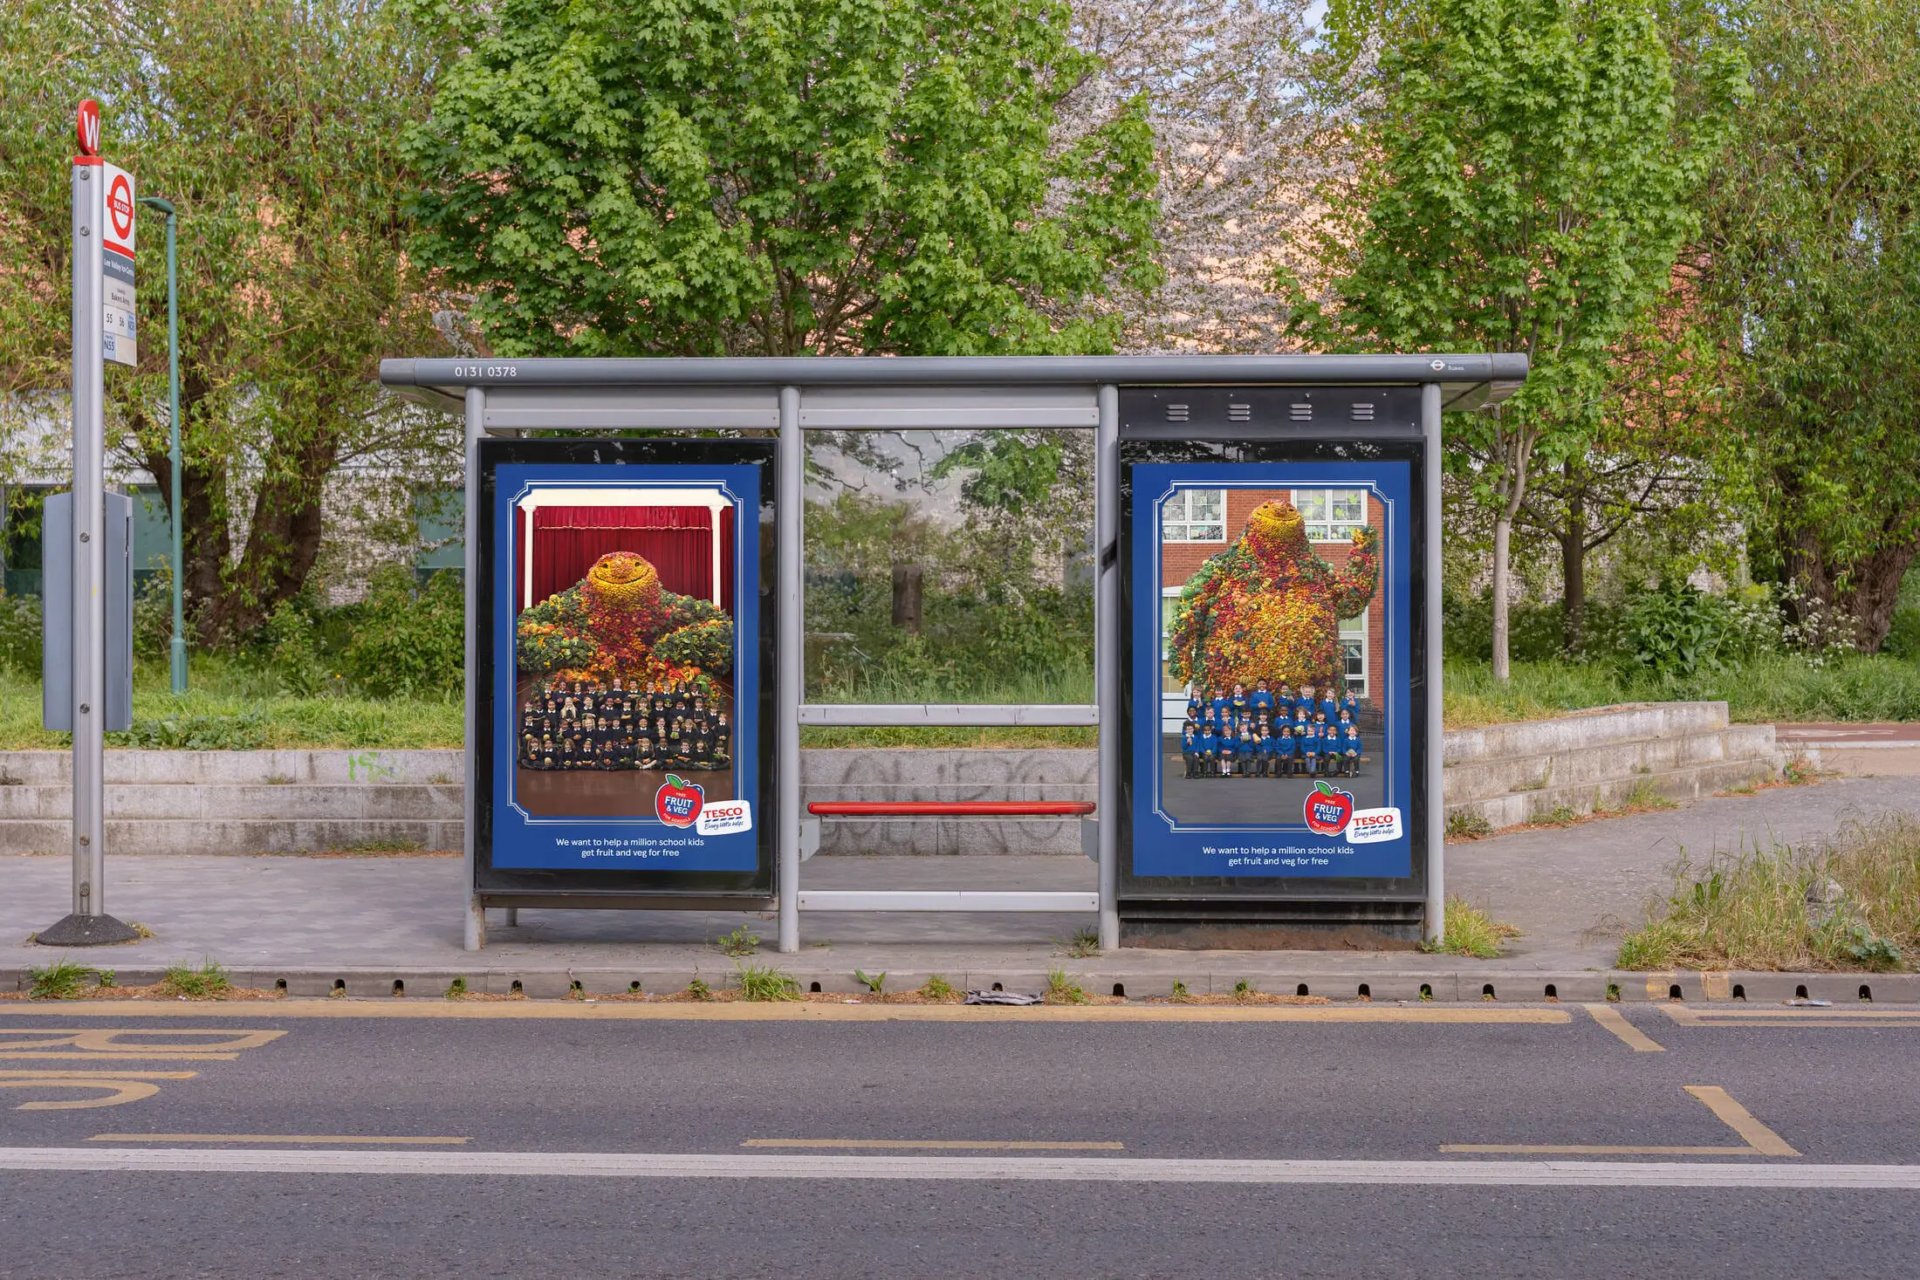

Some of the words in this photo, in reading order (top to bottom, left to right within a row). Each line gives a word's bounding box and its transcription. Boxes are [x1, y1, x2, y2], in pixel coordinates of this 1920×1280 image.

[83, 110, 100, 151] W
[106, 313, 113, 324] 55
[454, 366, 482, 377] 0131
[487, 366, 517, 377] 0378
[664, 795, 693, 808] FRUIT
[673, 806, 688, 815] VEG
[703, 807, 743, 819] TESCO
[1313, 803, 1343, 816] FRUIT
[1322, 814, 1338, 823] VEG
[1353, 814, 1394, 827] TESCO
[556, 838, 569, 846] We
[571, 838, 591, 846] want
[593, 838, 602, 846] to
[604, 838, 621, 847] help
[630, 838, 658, 846] million
[659, 838, 686, 846] school
[687, 838, 705, 846] kids
[581, 850, 595, 859] get
[596, 848, 613, 857] fruit
[615, 848, 631, 857] and
[633, 850, 648, 859] veg
[648, 848, 660, 857] for
[662, 848, 680, 857] free
[1203, 846, 1217, 855] We
[1218, 846, 1238, 855] want
[1240, 847, 1249, 855] to
[1251, 846, 1270, 856] help
[1278, 846, 1306, 855] million
[1307, 846, 1335, 855] school
[1337, 846, 1355, 855] kids
[1228, 858, 1242, 867] get
[1243, 857, 1261, 865] fruit
[1263, 857, 1280, 865] and
[1281, 859, 1296, 867] veg
[1297, 857, 1309, 865] for
[1311, 857, 1329, 865] free
